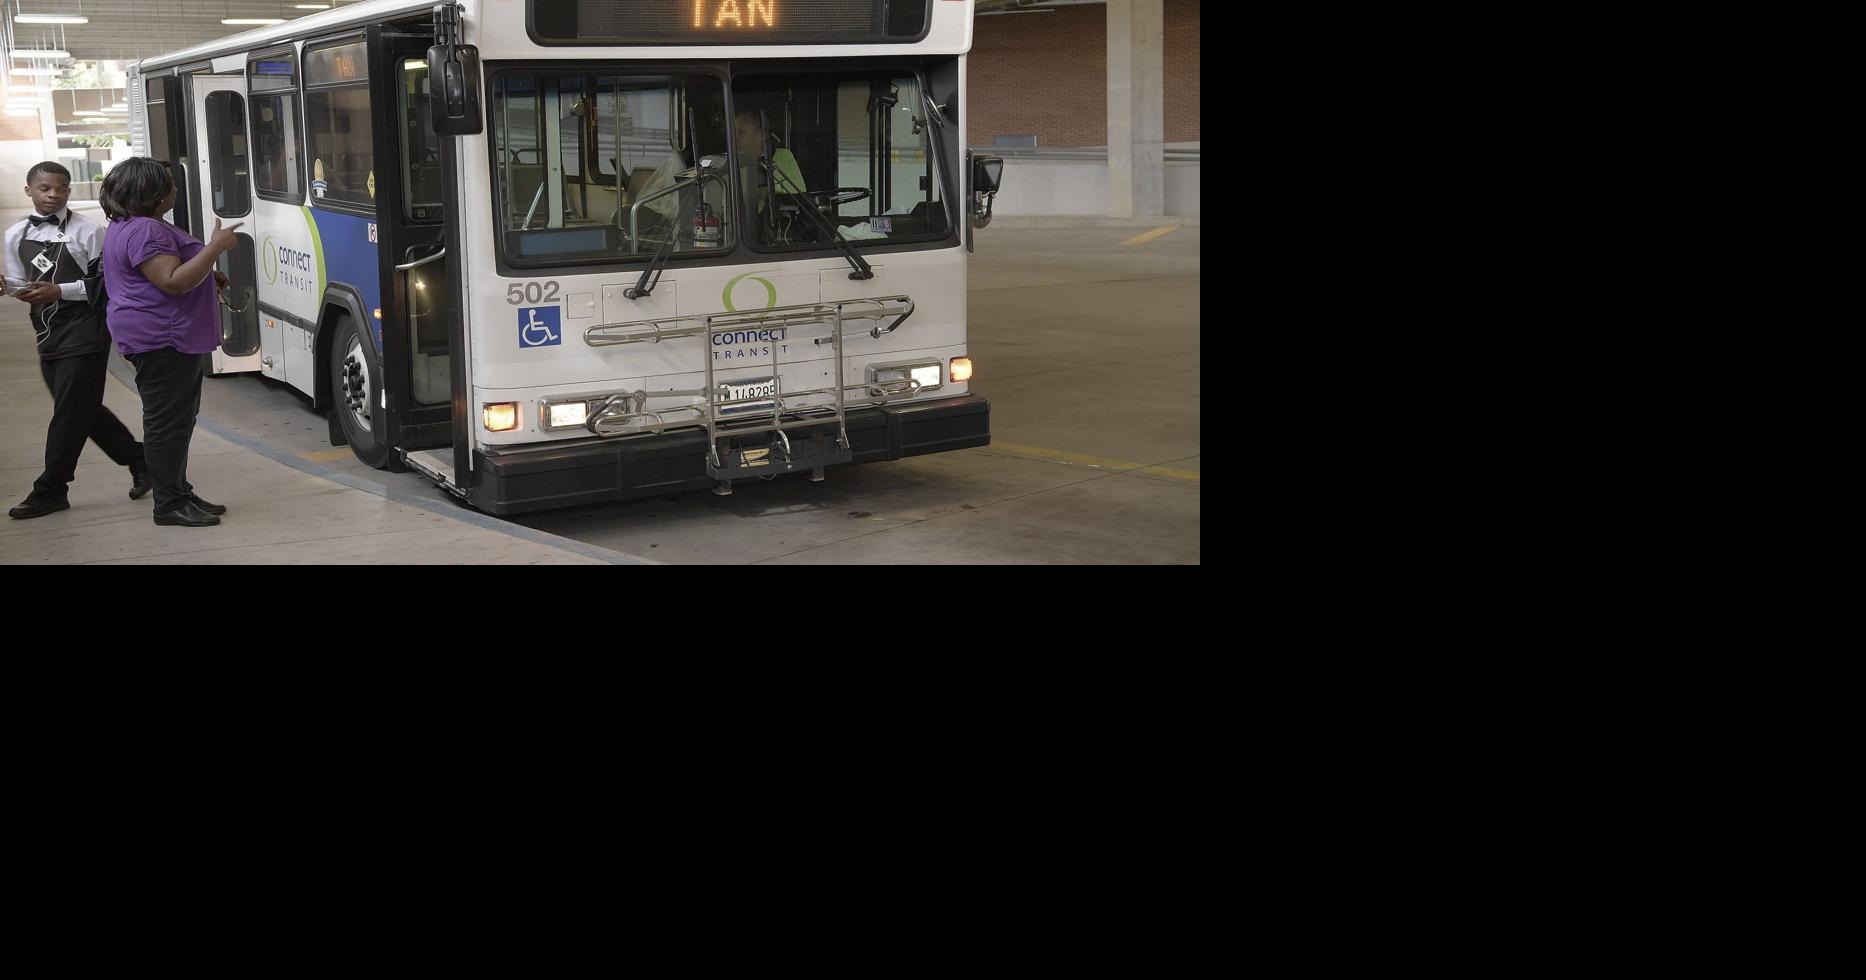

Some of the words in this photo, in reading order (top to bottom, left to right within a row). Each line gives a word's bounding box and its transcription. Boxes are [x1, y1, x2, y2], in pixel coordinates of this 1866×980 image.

[280, 270, 312, 294] TRANSIT
[506, 280, 561, 305] 502
[713, 344, 788, 360] TRANST
